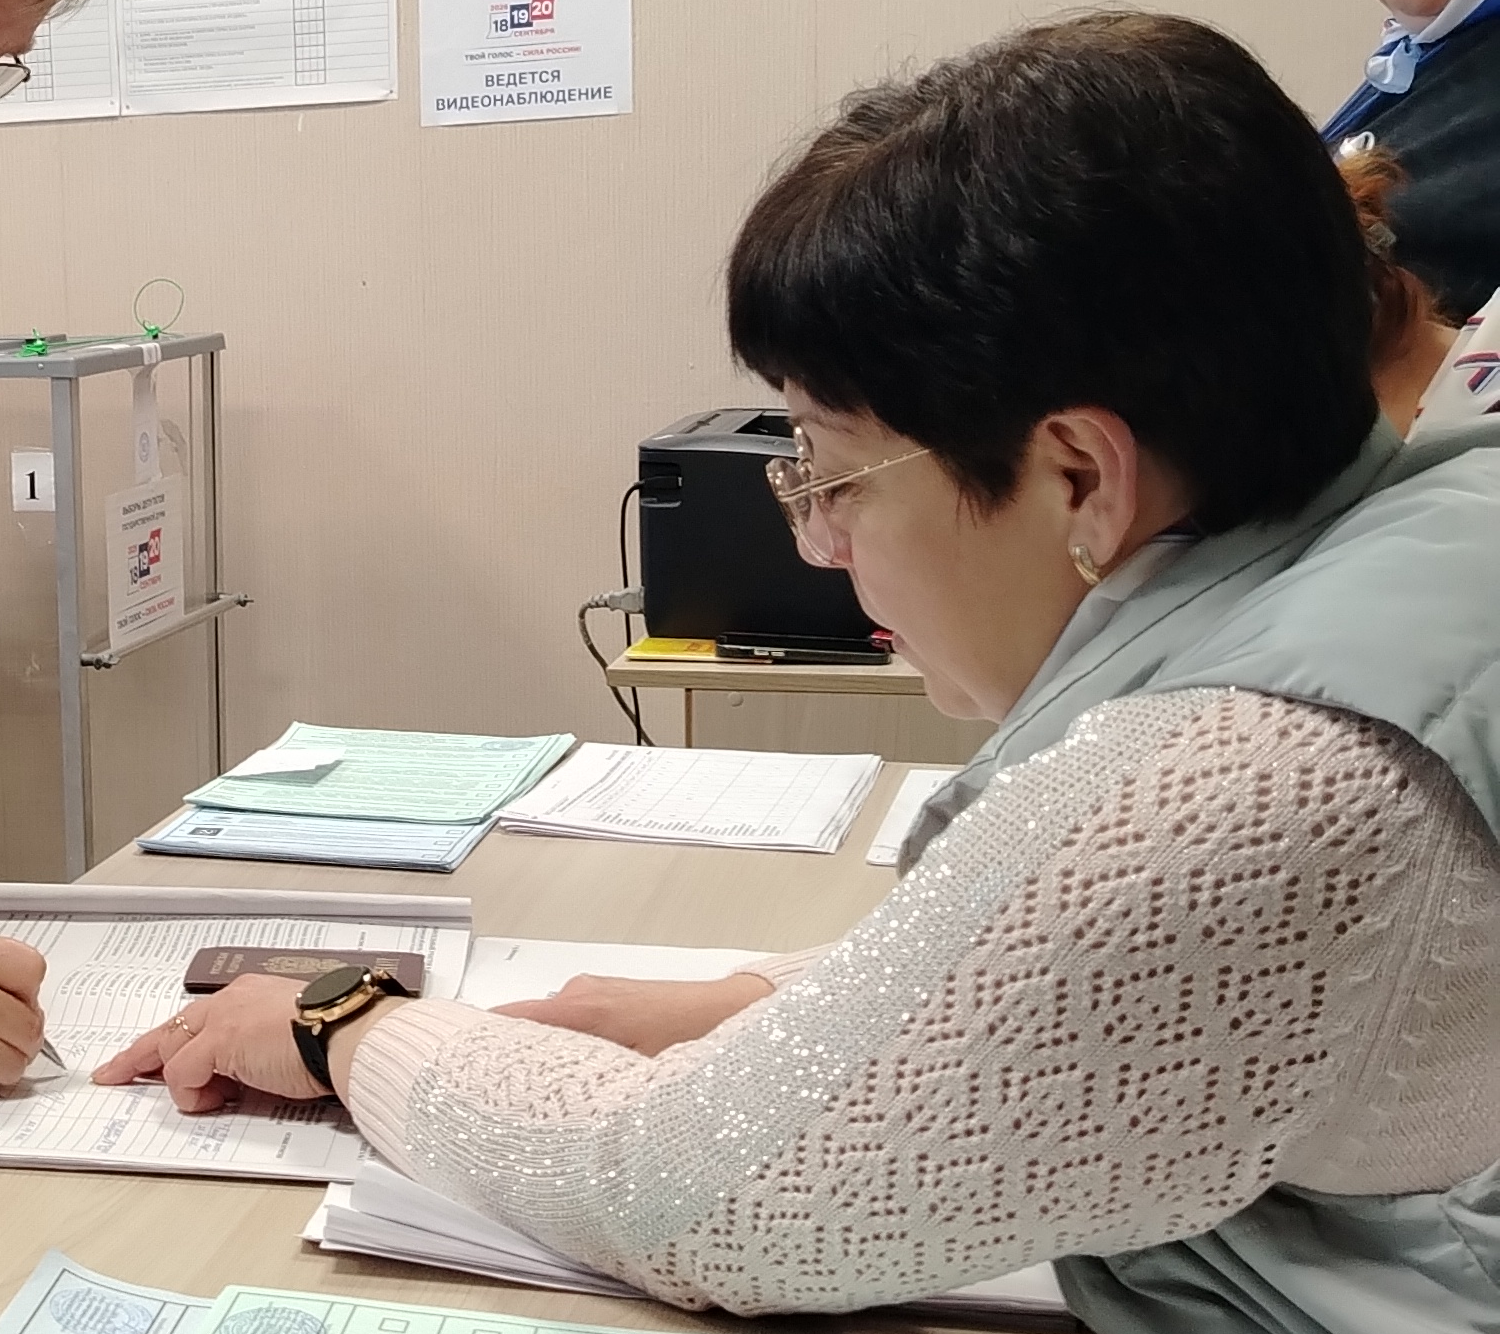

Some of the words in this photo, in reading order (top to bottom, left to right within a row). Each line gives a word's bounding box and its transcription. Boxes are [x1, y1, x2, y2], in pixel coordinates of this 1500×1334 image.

[532, 1, 552, 15] 20
[512, 10, 528, 24] 19
[493, 19, 508, 33] 18
[514, 27, 555, 37] СЕНТЯБРЯ
[464, 52, 485, 62] ТВОЙ
[488, 51, 514, 59] ГОЛОС
[522, 48, 544, 56] СИЛА
[485, 70, 561, 88] ВЕДЕТСЯ
[436, 86, 613, 111] ВИДЕОНАБЛЮДЕНИЕ
[24, 470, 40, 500] 1
